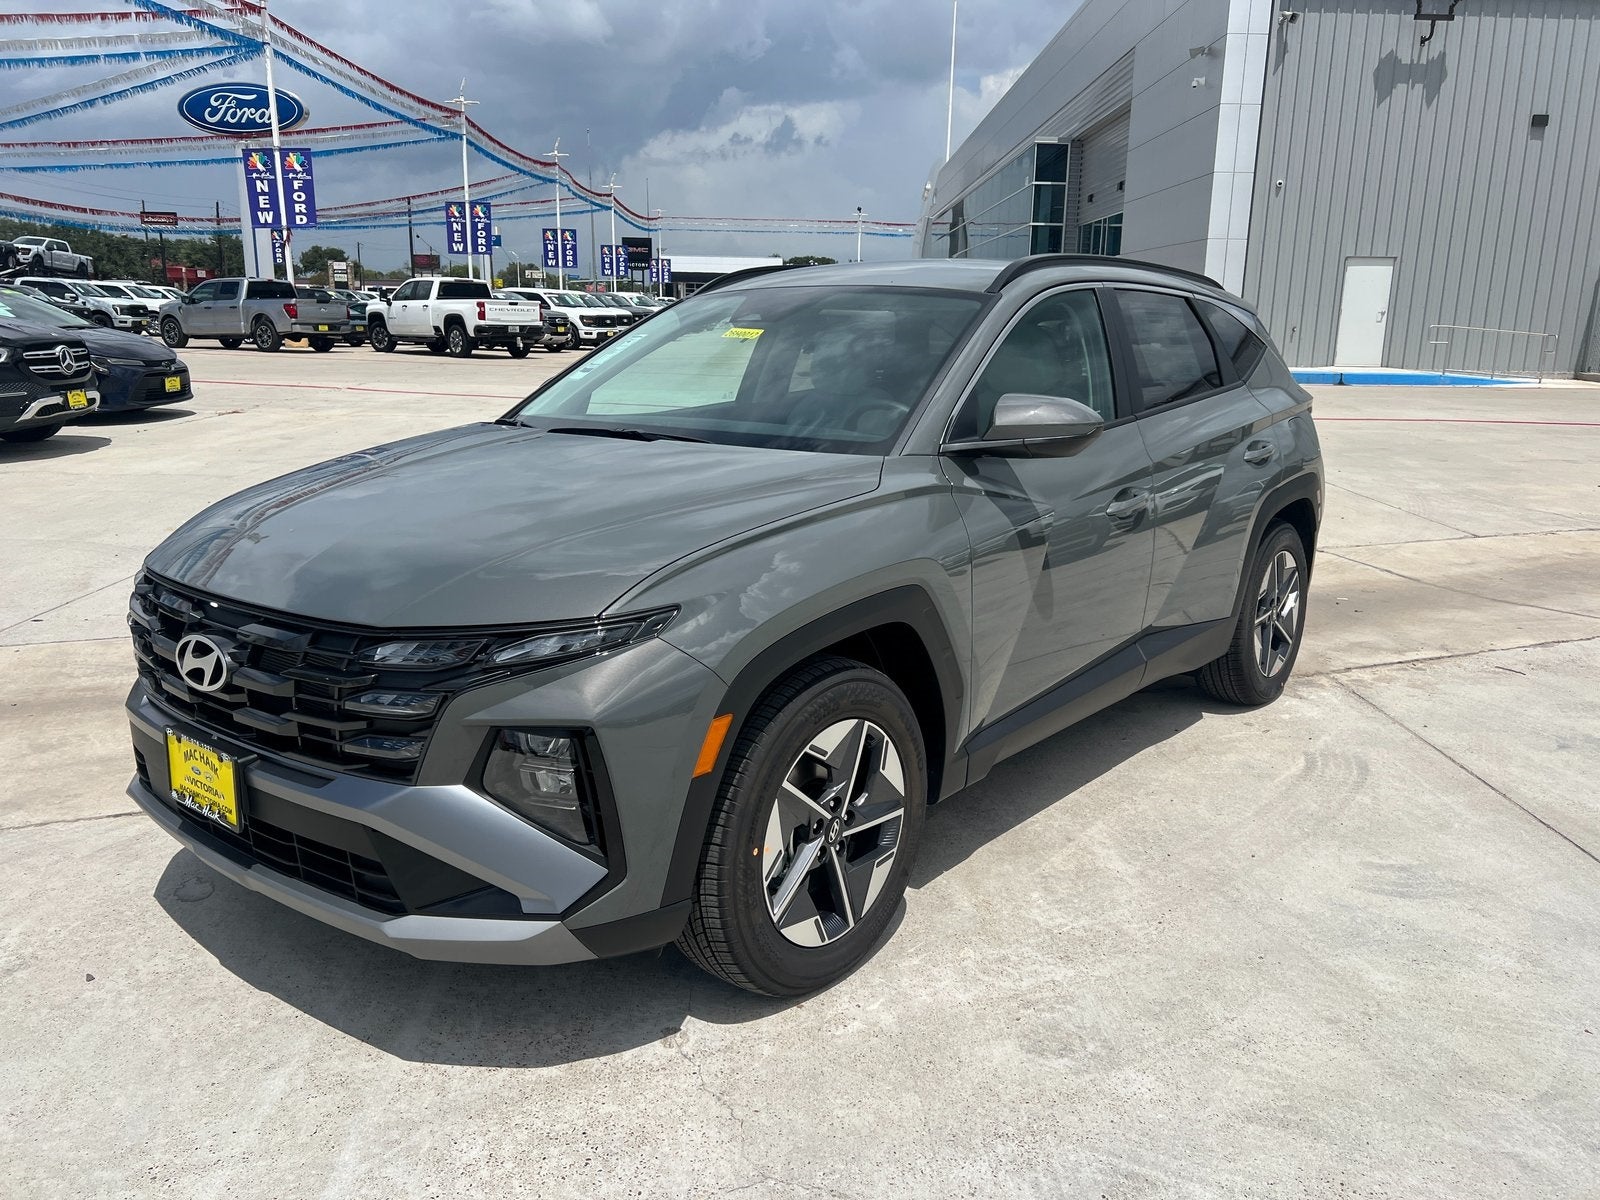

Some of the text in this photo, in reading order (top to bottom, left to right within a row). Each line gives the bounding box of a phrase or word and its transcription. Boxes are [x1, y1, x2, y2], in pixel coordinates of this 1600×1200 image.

[255, 179, 274, 224] NEW
[292, 179, 308, 225] FORD
[452, 222, 464, 252] NEW
[476, 222, 487, 253] FORD
[547, 243, 556, 266] NEW
[565, 244, 574, 267] FORD
